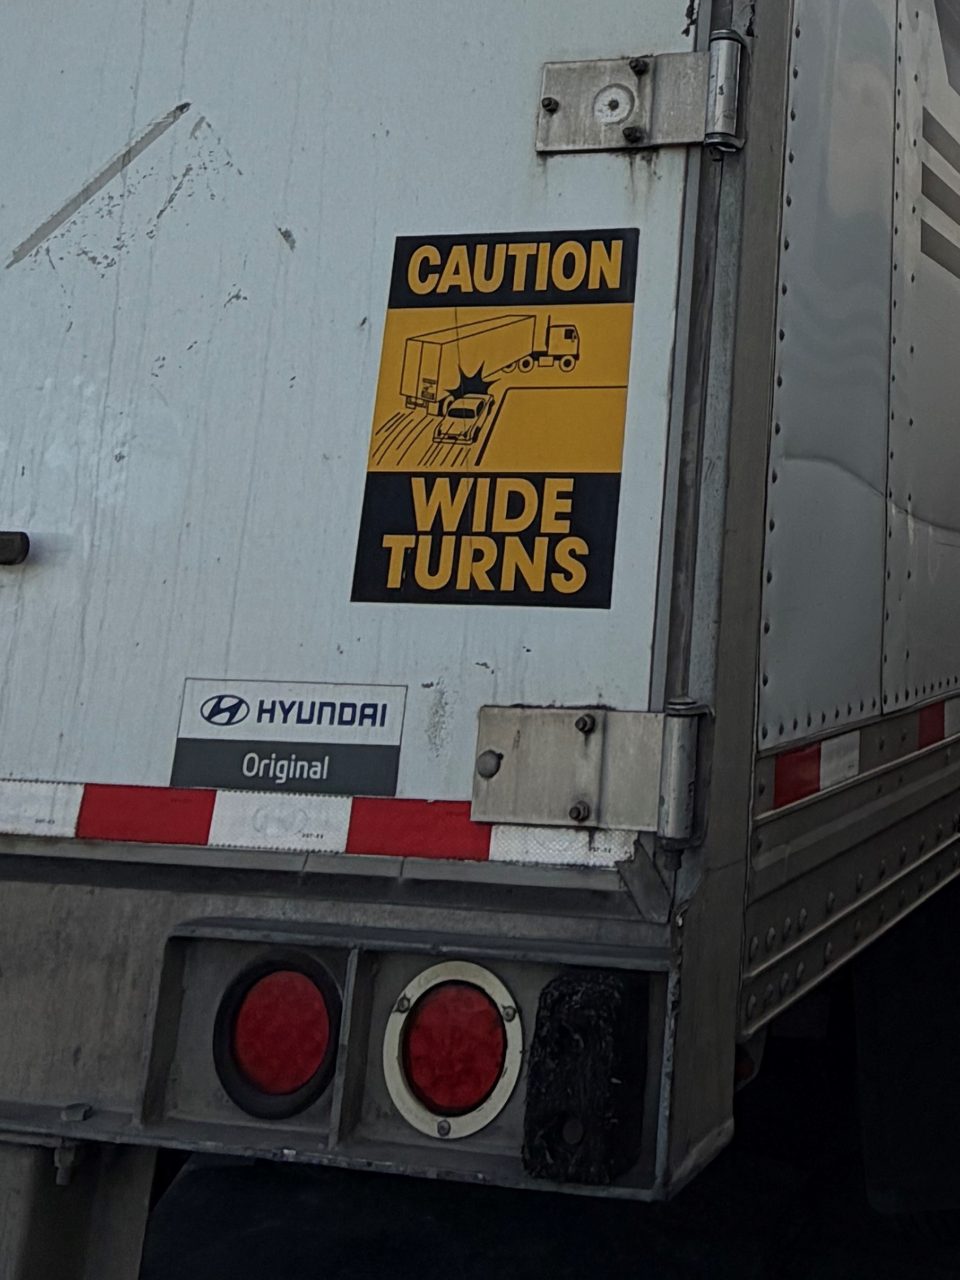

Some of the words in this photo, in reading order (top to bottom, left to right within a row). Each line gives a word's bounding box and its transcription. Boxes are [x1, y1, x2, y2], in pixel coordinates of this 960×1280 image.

[407, 241, 623, 294] CAUTION
[411, 477, 574, 534] WIDE
[382, 535, 590, 594] TURNS
[256, 699, 387, 727] HYUNDAI
[242, 752, 329, 784] Original
